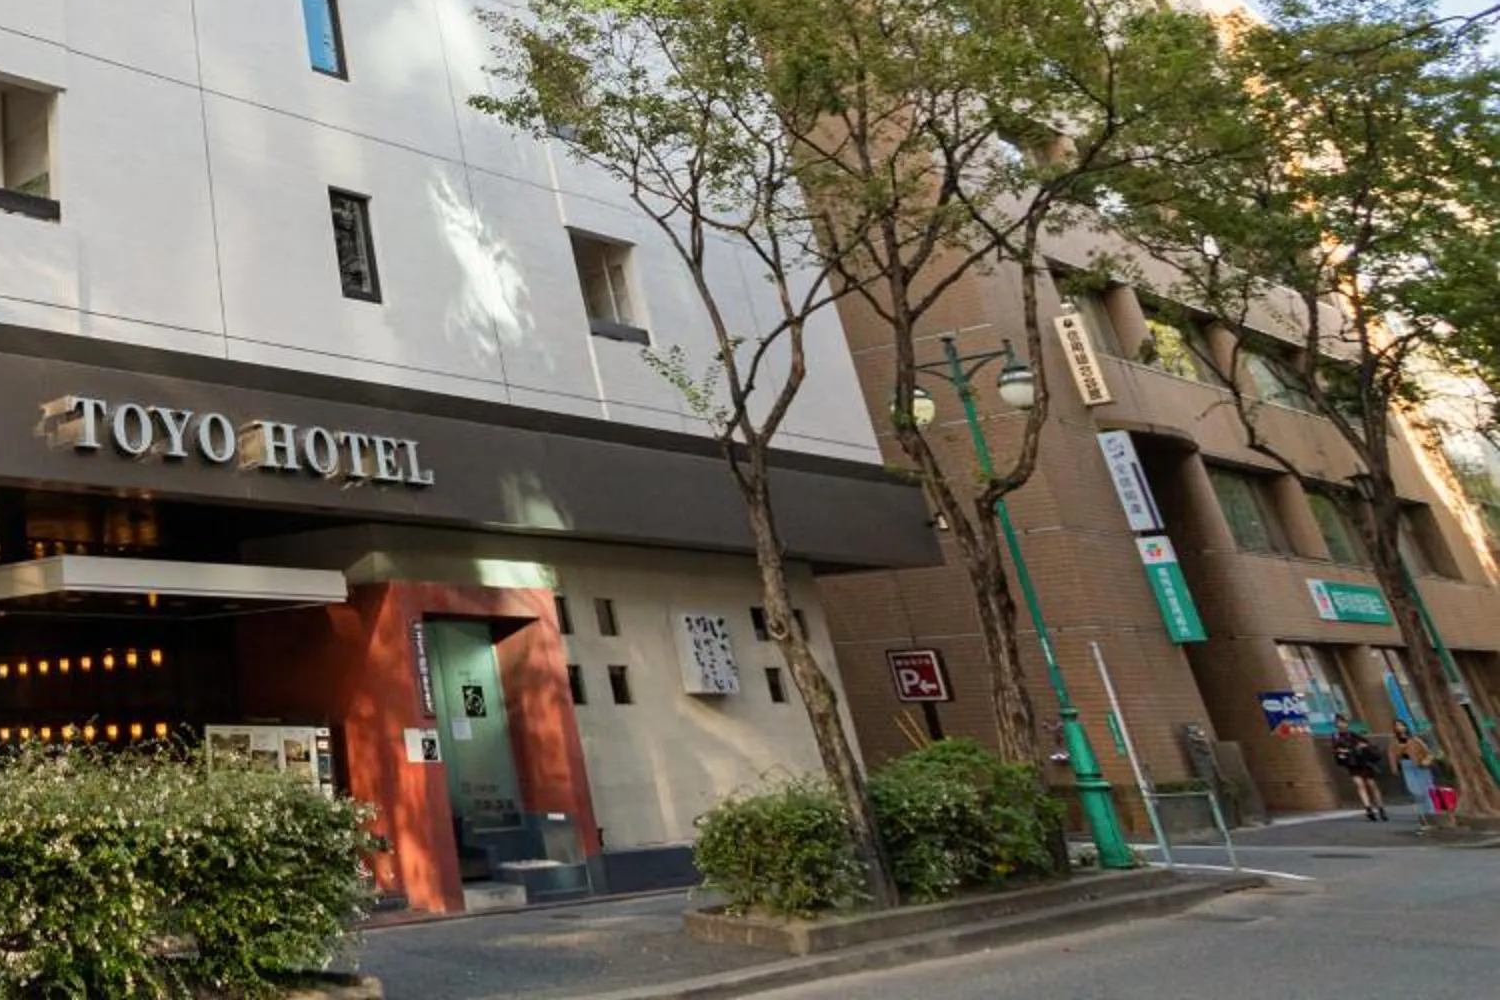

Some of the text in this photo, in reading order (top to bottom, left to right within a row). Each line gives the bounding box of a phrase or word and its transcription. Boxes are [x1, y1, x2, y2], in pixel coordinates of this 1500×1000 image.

[71, 396, 435, 486] TOYO HOTEL
[899, 668, 920, 695] P
